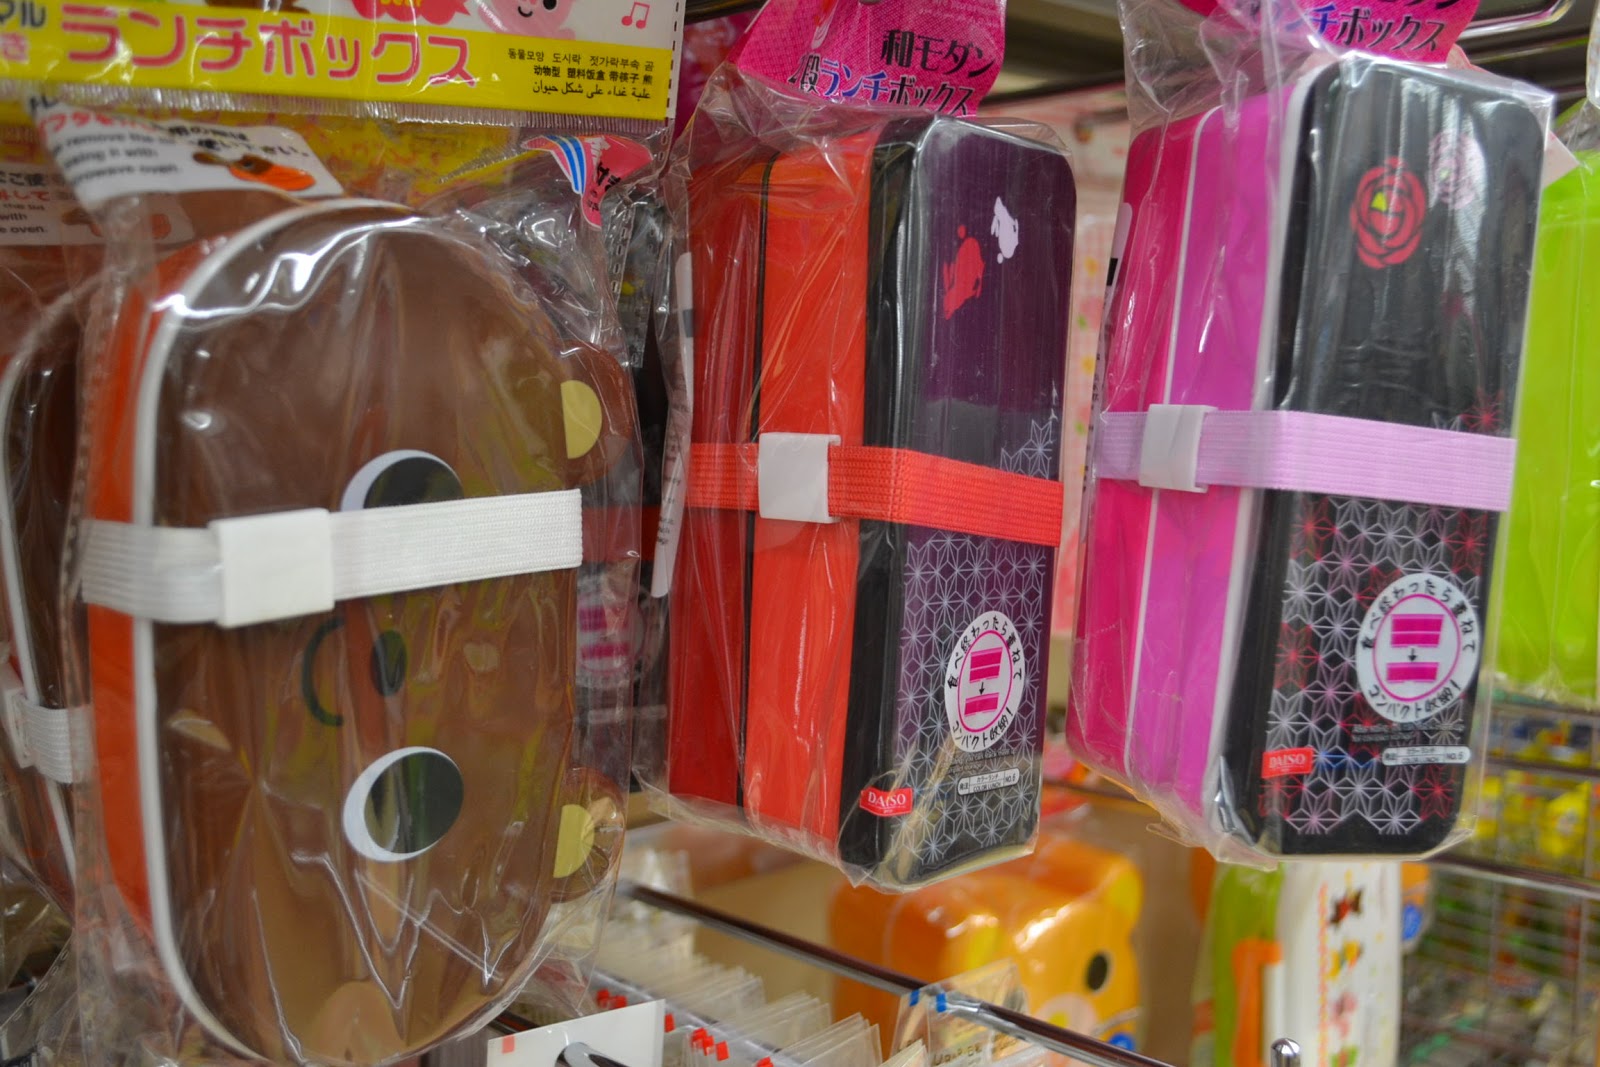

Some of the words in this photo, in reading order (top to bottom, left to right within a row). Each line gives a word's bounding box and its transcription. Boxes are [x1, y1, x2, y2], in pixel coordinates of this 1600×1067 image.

[61, 4, 477, 88] ランチボックス
[880, 29, 996, 78] 和モダン
[507, 48, 544, 62] 동물모양
[552, 52, 582, 64] 도시락
[589, 55, 640, 71] 젓가락부속
[644, 61, 654, 72] 곰
[533, 65, 560, 78] 动物型
[788, 53, 976, 116] 段ランチボックス
[1269, 753, 1306, 769] DAISO
[868, 791, 906, 808] DAISO
